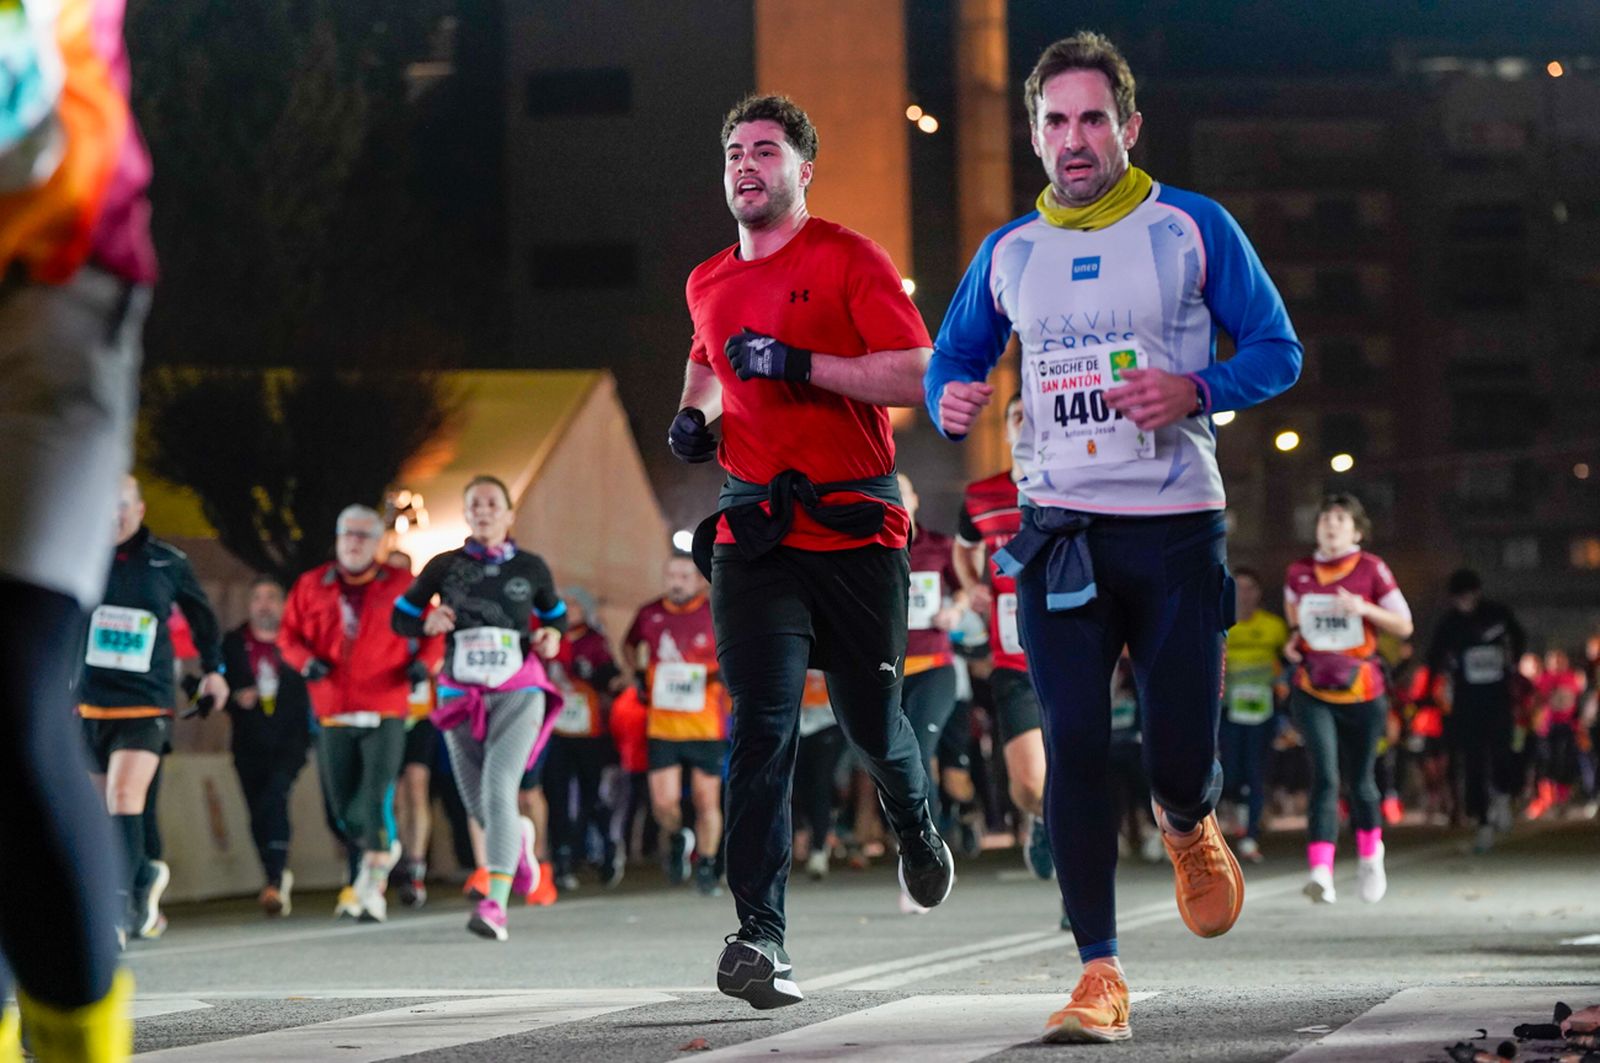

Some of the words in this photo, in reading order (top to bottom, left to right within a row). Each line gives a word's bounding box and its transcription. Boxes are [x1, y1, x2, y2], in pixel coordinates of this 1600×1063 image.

[1073, 263, 1098, 273] UNED
[1037, 309, 1134, 336] XXVII
[1049, 360, 1083, 377] NOCHE
[1086, 359, 1099, 371] DE
[1041, 379, 1059, 393] SAN
[1061, 373, 1101, 390] ANTÓN
